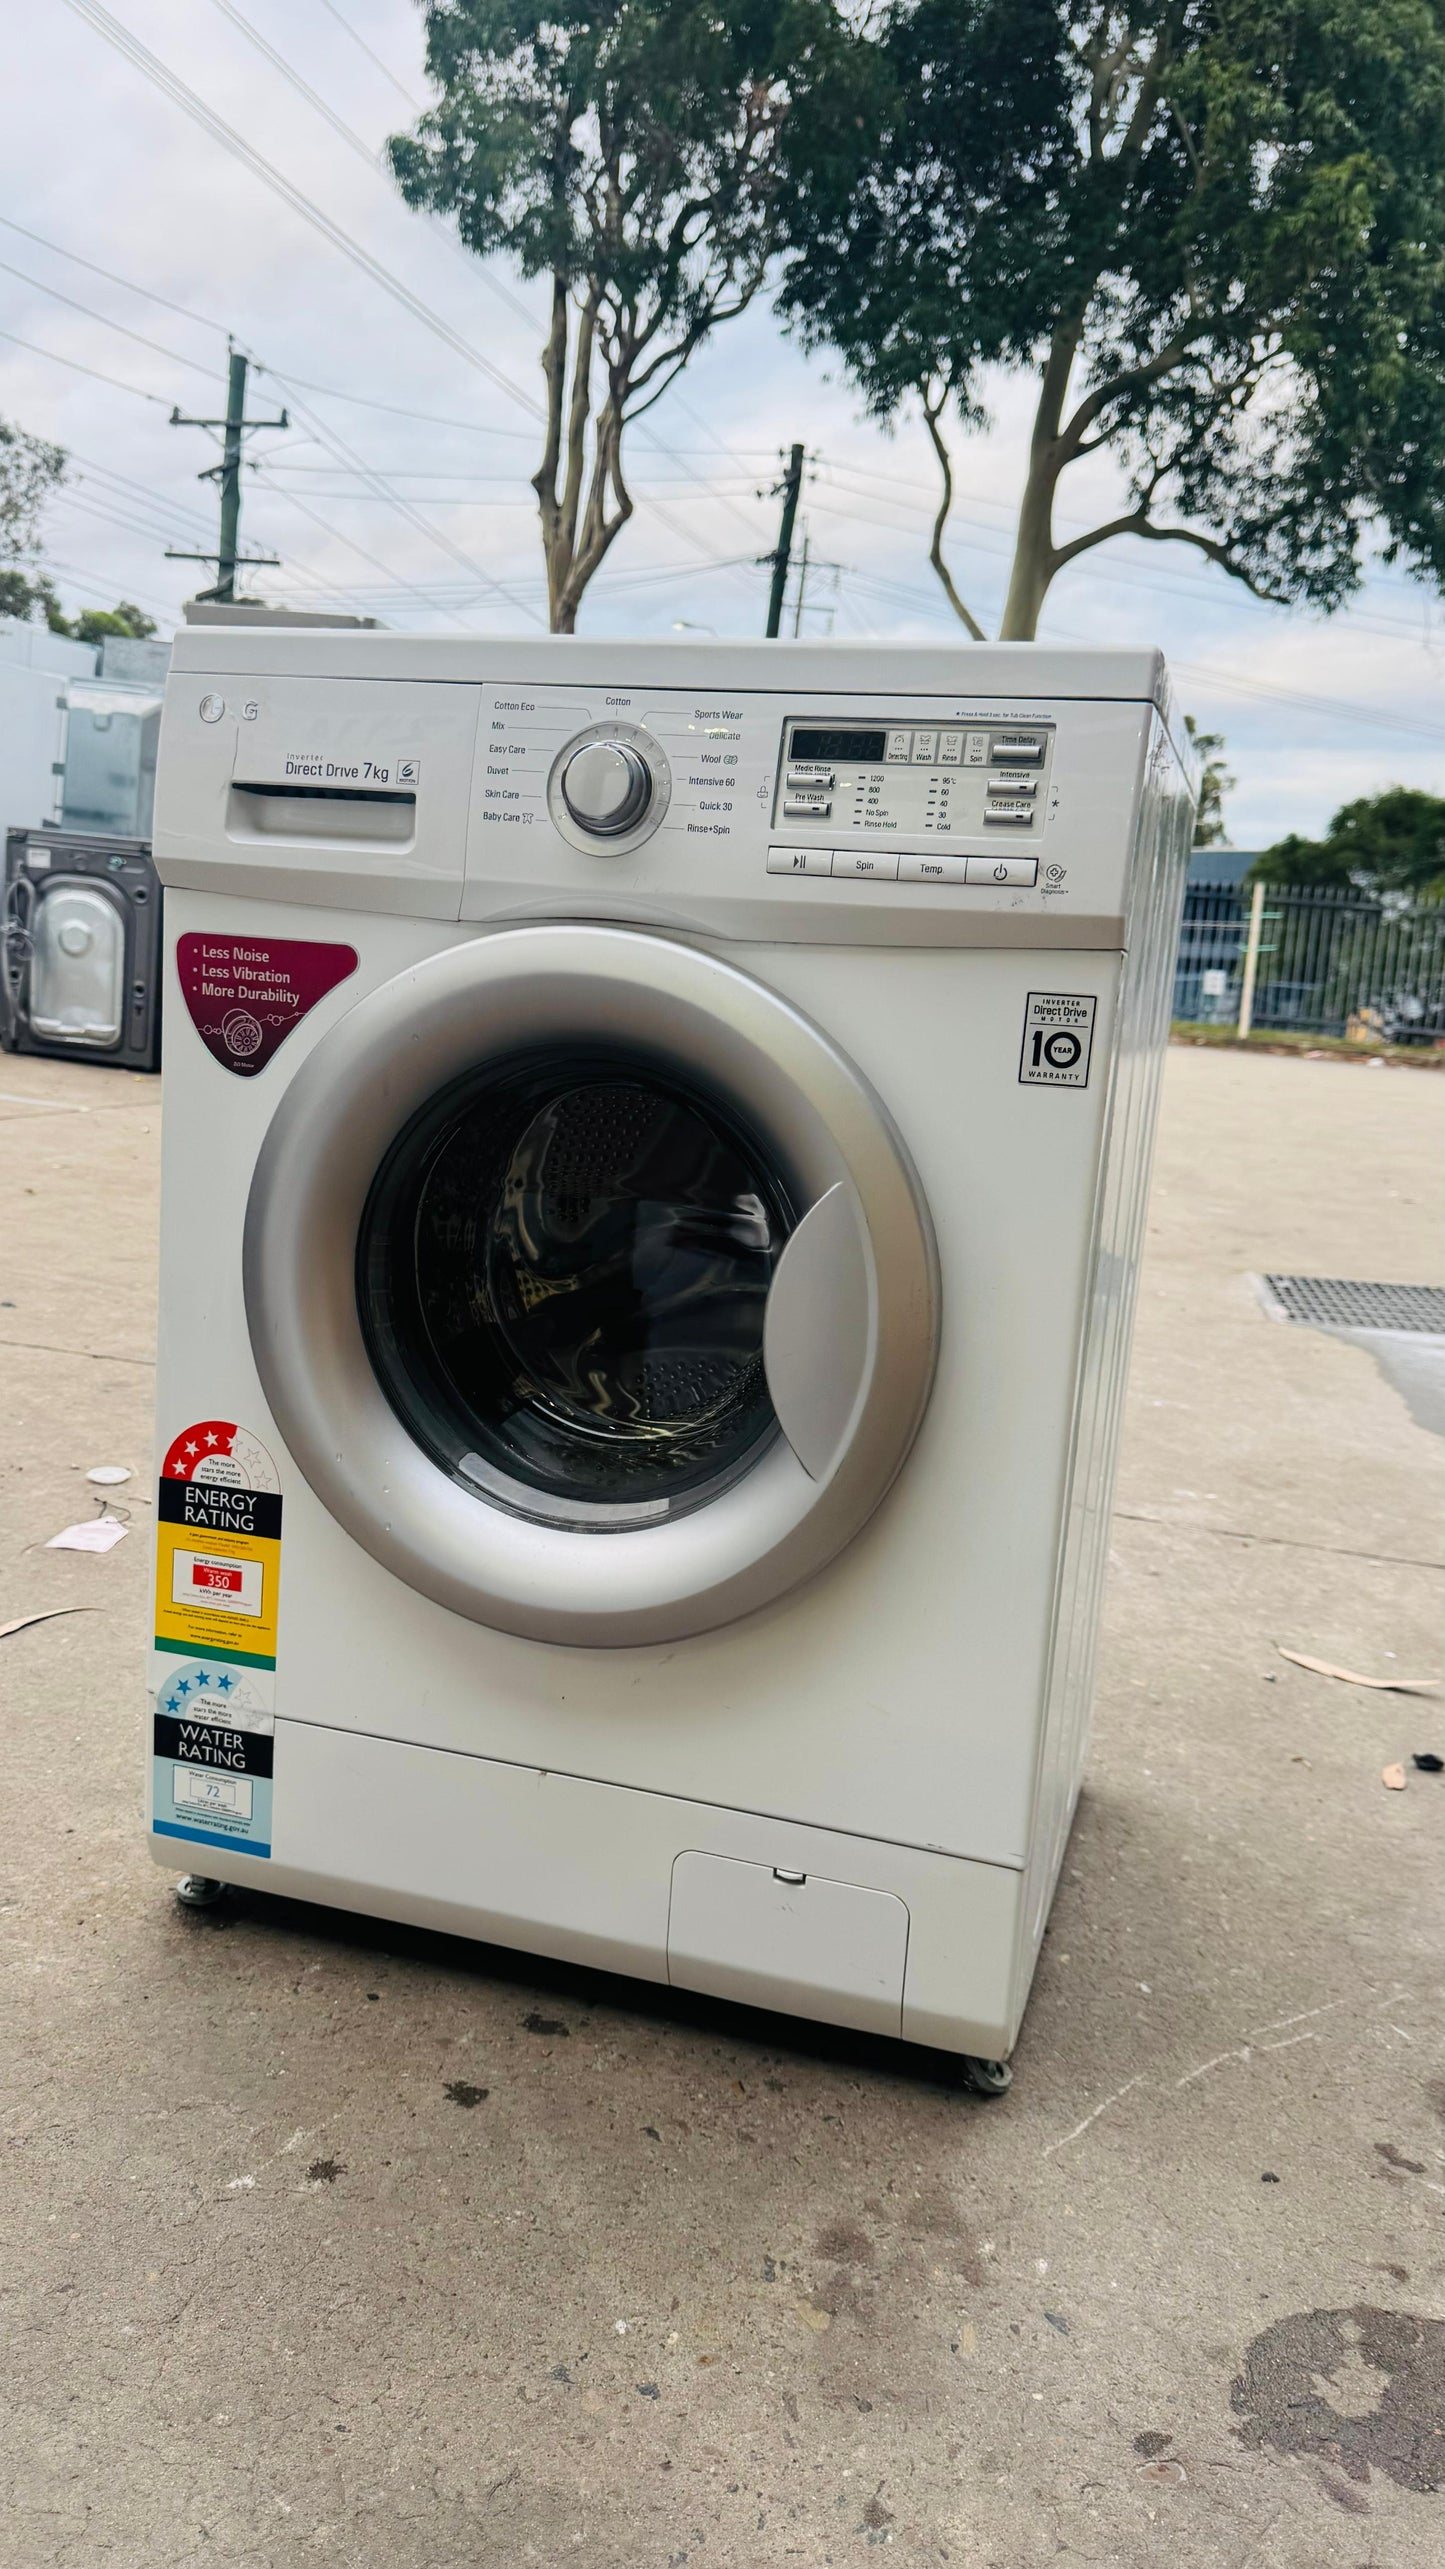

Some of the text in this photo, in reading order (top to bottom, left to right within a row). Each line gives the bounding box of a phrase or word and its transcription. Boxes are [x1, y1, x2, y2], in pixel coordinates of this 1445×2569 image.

[494, 701, 535, 711] Cotton Eco
[605, 696, 631, 706] Cotton
[694, 710, 743, 720] Sports Wear
[491, 721, 505, 730] Mix
[709, 731, 741, 741] Delicate
[1002, 735, 1037, 745] Time Delay
[489, 744, 526, 754] Easy Care
[701, 754, 721, 764] Wool
[888, 752, 908, 761] Detecting
[916, 753, 932, 761] Wash
[942, 753, 958, 762] Rinse
[970, 755, 983, 763] Spin
[286, 761, 322, 777] Direct
[326, 763, 359, 778] Drive
[487, 766, 509, 775] Duvet
[795, 764, 831, 773] Medic Rinse
[1000, 771, 1030, 779] Intensive
[688, 776, 735, 787] Intensive 60
[485, 789, 519, 799] Skin Care
[795, 793, 805, 801] Pre
[699, 801, 733, 811] Quick 30
[991, 800, 1015, 808] Crease
[483, 811, 520, 822] Baby Care
[938, 811, 947, 819] 30
[687, 823, 730, 835] Rinse+Spin
[864, 820, 898, 829] Rinse Hold
[936, 823, 951, 831] Cold
[855, 860, 874, 871] Spin
[202, 944, 270, 963] Less Noise
[202, 963, 291, 984] Less Vibration
[202, 982, 300, 1008] More Durability
[1042, 998, 1081, 1007] INVERTER
[1033, 1004, 1088, 1018] Direct Drive
[1041, 1016, 1079, 1024] MOTOR
[1032, 1030, 1082, 1069] 10
[1053, 1046, 1073, 1055] YEAR
[1028, 1070, 1080, 1081] WARRANTY
[209, 1458, 236, 1469] The more
[201, 1466, 214, 1474] stars
[226, 1470, 241, 1478] more
[200, 1474, 242, 1485] energy efficient
[185, 1486, 258, 1512] ENERGY
[184, 1505, 255, 1532] RATING
[193, 1556, 242, 1569] Energy consumption
[207, 1573, 230, 1589] 350
[200, 1698, 227, 1709] The more
[193, 1706, 232, 1718] stars the more
[179, 1723, 244, 1751] WATER
[178, 1740, 246, 1769] RATING
[189, 1770, 237, 1785] Water Consumption
[206, 1784, 220, 1798] 72
[176, 1813, 249, 1834] www.waterrating.gov.au
